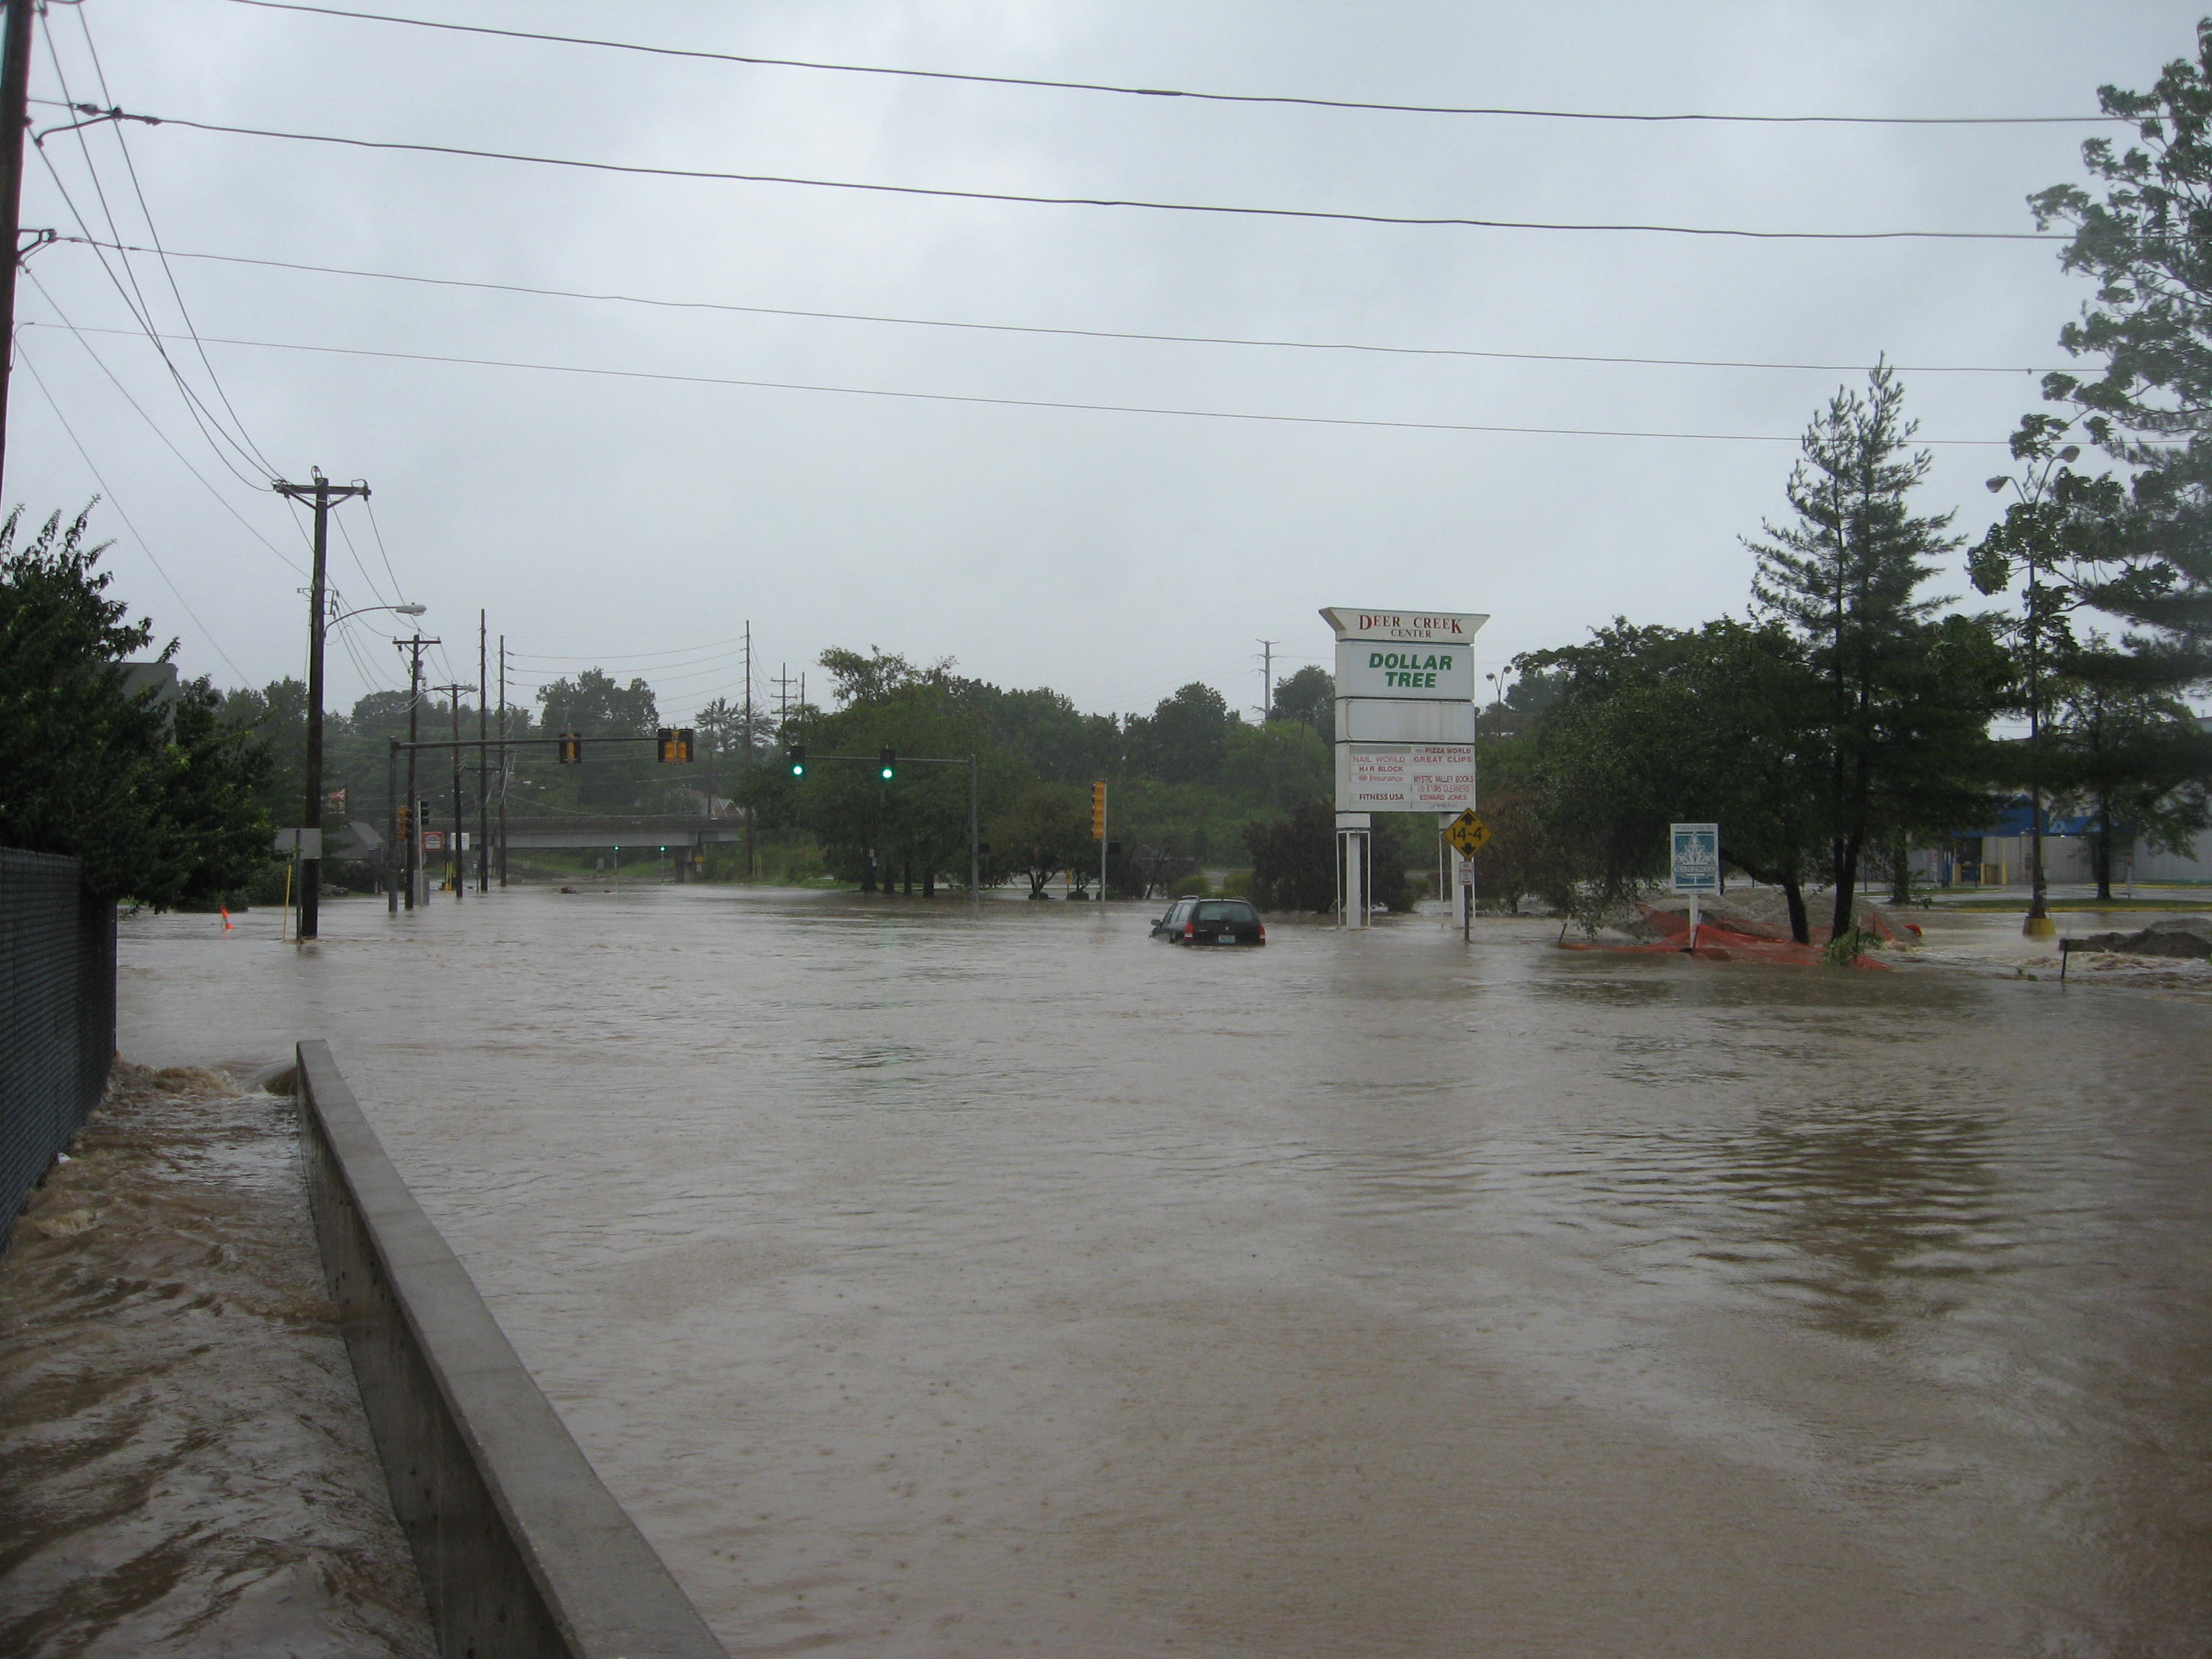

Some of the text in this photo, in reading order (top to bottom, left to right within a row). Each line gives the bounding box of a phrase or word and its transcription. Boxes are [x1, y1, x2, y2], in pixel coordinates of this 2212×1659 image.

[1359, 615, 1464, 634] DEER CREEK
[1390, 629, 1431, 638] CENTER
[1369, 652, 1453, 670] DOLLAR
[1385, 671, 1437, 688] TREE
[1452, 827, 1482, 841] 14-4
